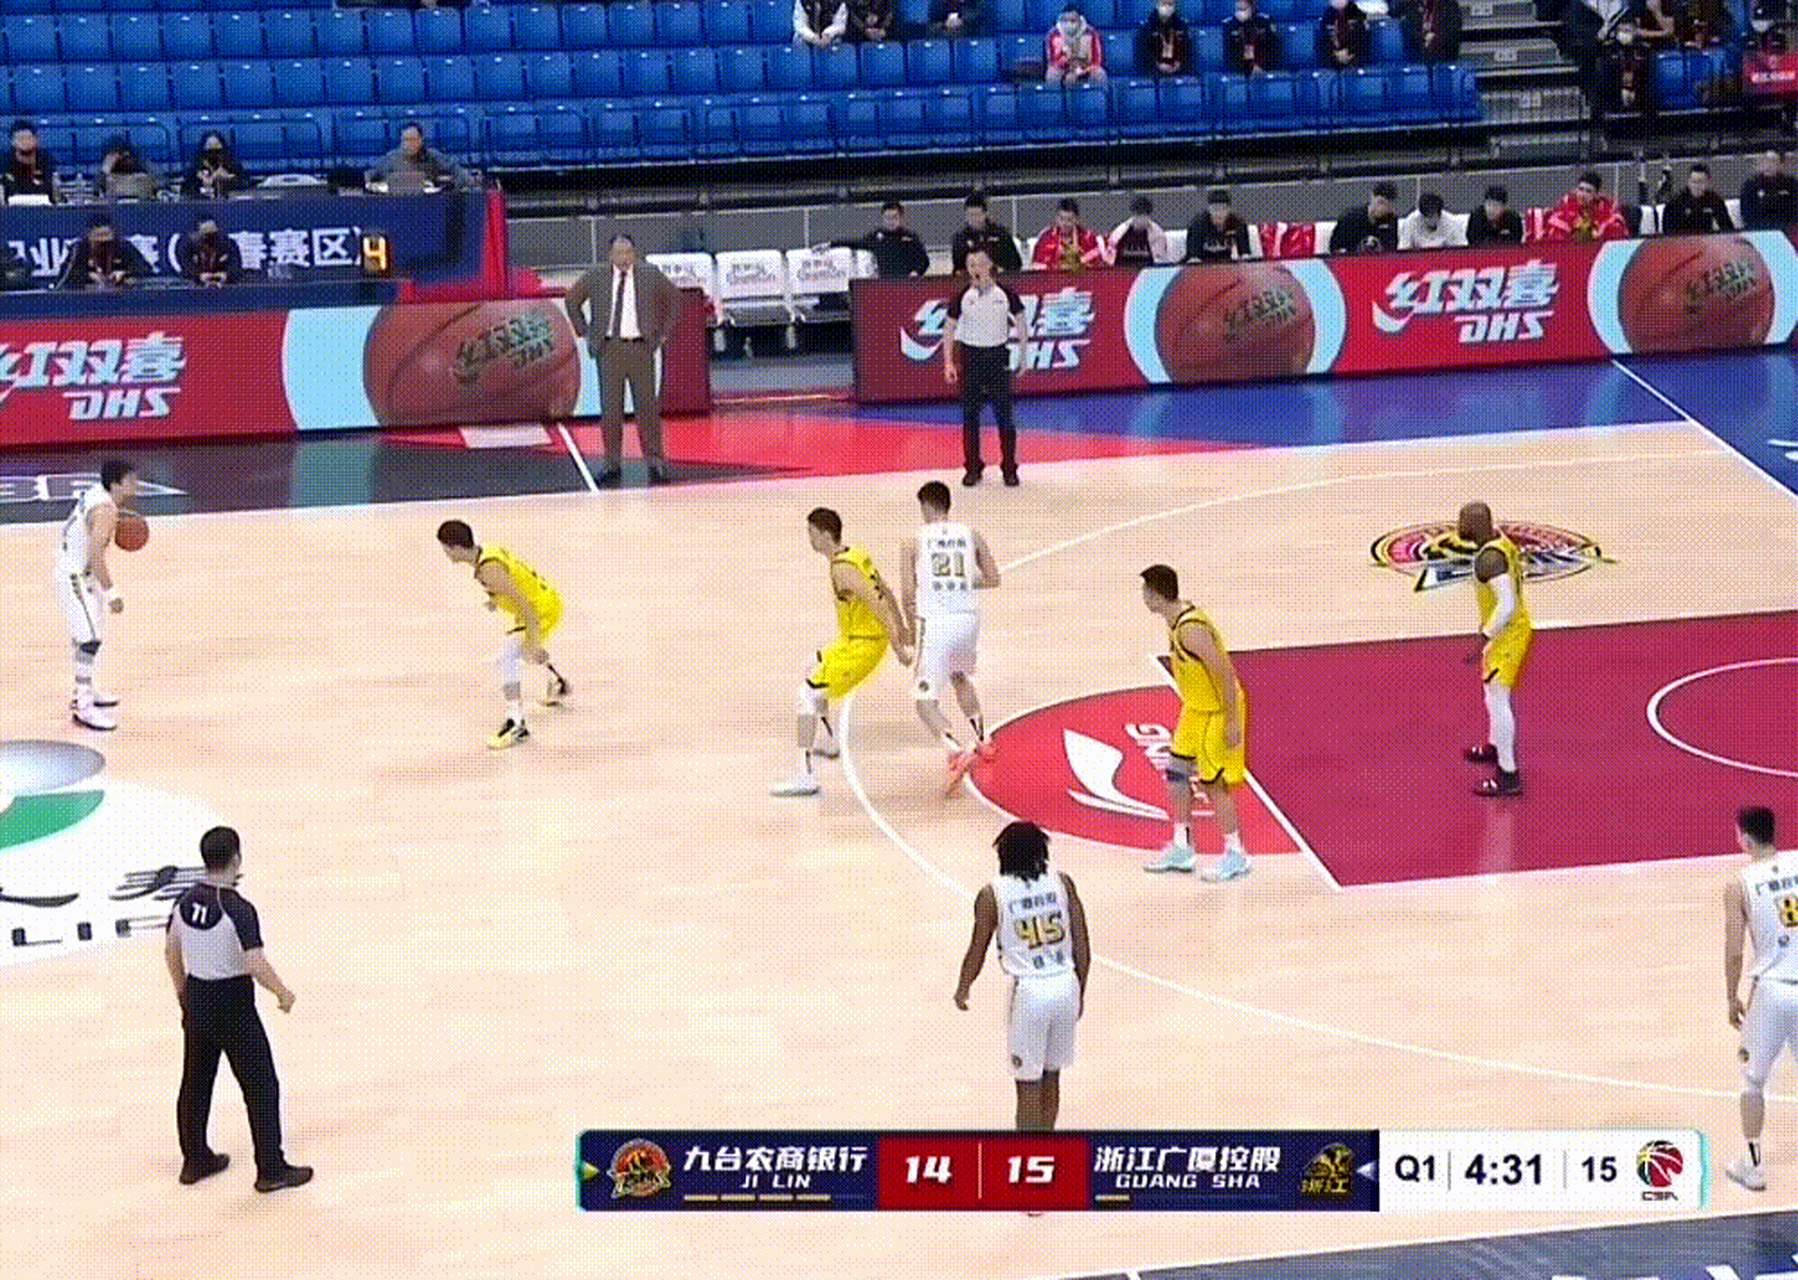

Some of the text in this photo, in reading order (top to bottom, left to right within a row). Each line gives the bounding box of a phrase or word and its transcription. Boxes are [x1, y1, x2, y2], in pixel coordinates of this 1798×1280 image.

[1375, 258, 1561, 318] 红双喜
[1454, 310, 1554, 344] DHS
[63, 386, 182, 420] DHS
[931, 551, 966, 577] 21
[1013, 910, 1067, 950] 45
